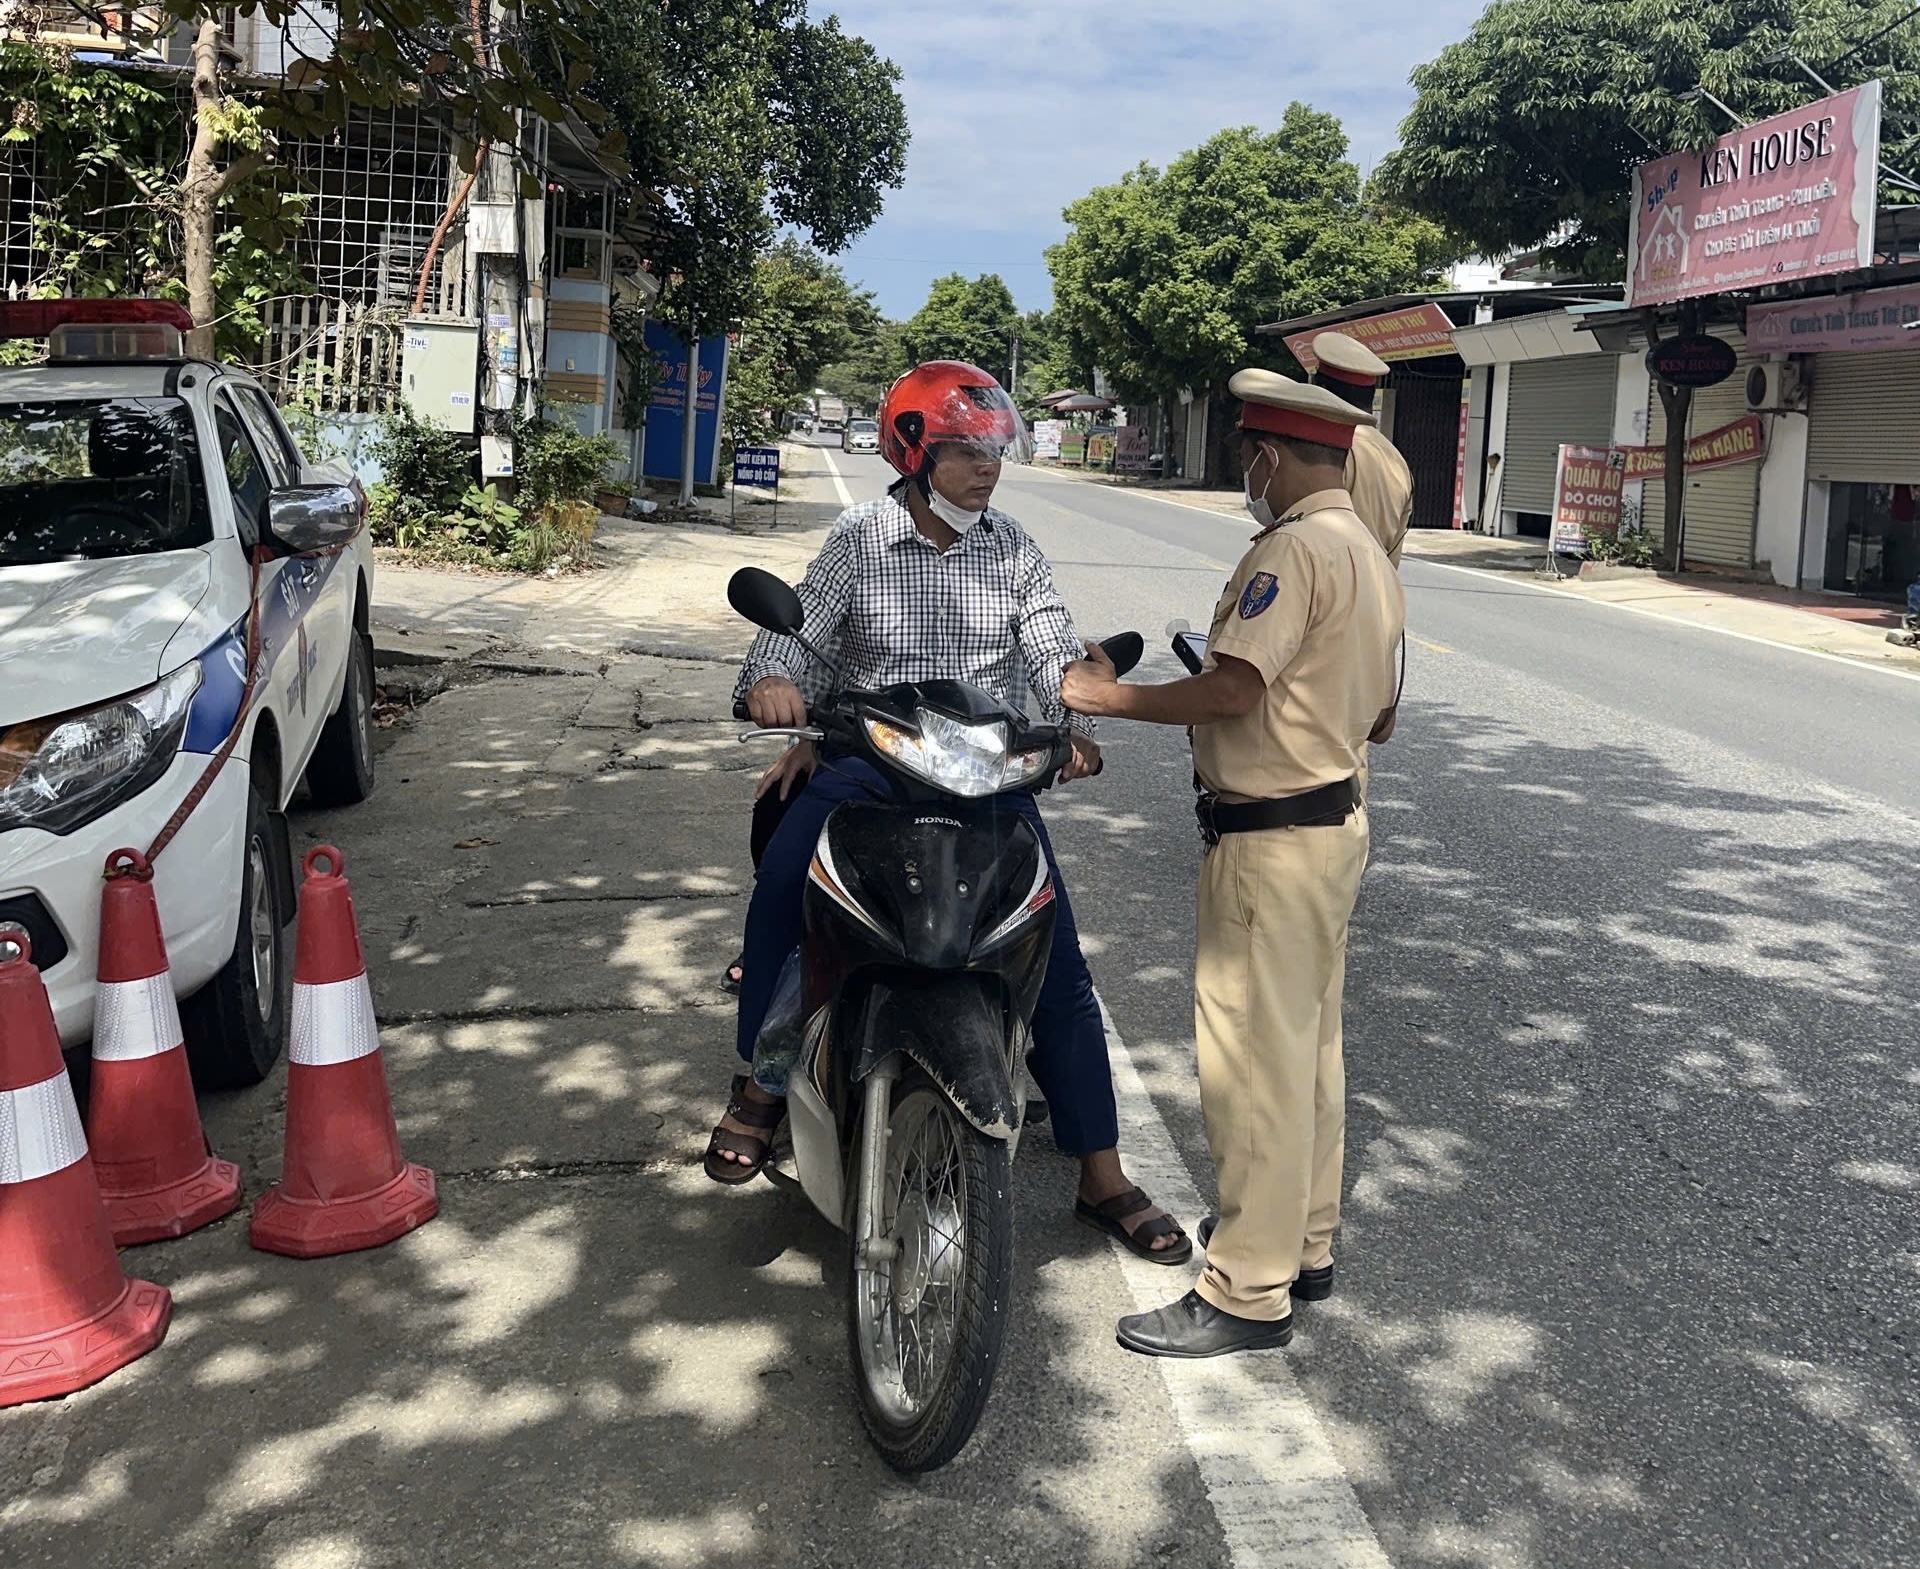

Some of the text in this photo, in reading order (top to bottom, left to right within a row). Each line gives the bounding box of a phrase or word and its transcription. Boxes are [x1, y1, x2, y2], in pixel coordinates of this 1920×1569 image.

[1700, 115, 1836, 188] KEN HOUSE
[1752, 194, 1783, 216] TRANG
[1565, 461, 1600, 488] QUẦN
[1586, 493, 1618, 508] CHƠI
[1560, 507, 1586, 524] PHỤ
[914, 816, 963, 828] HONDA
